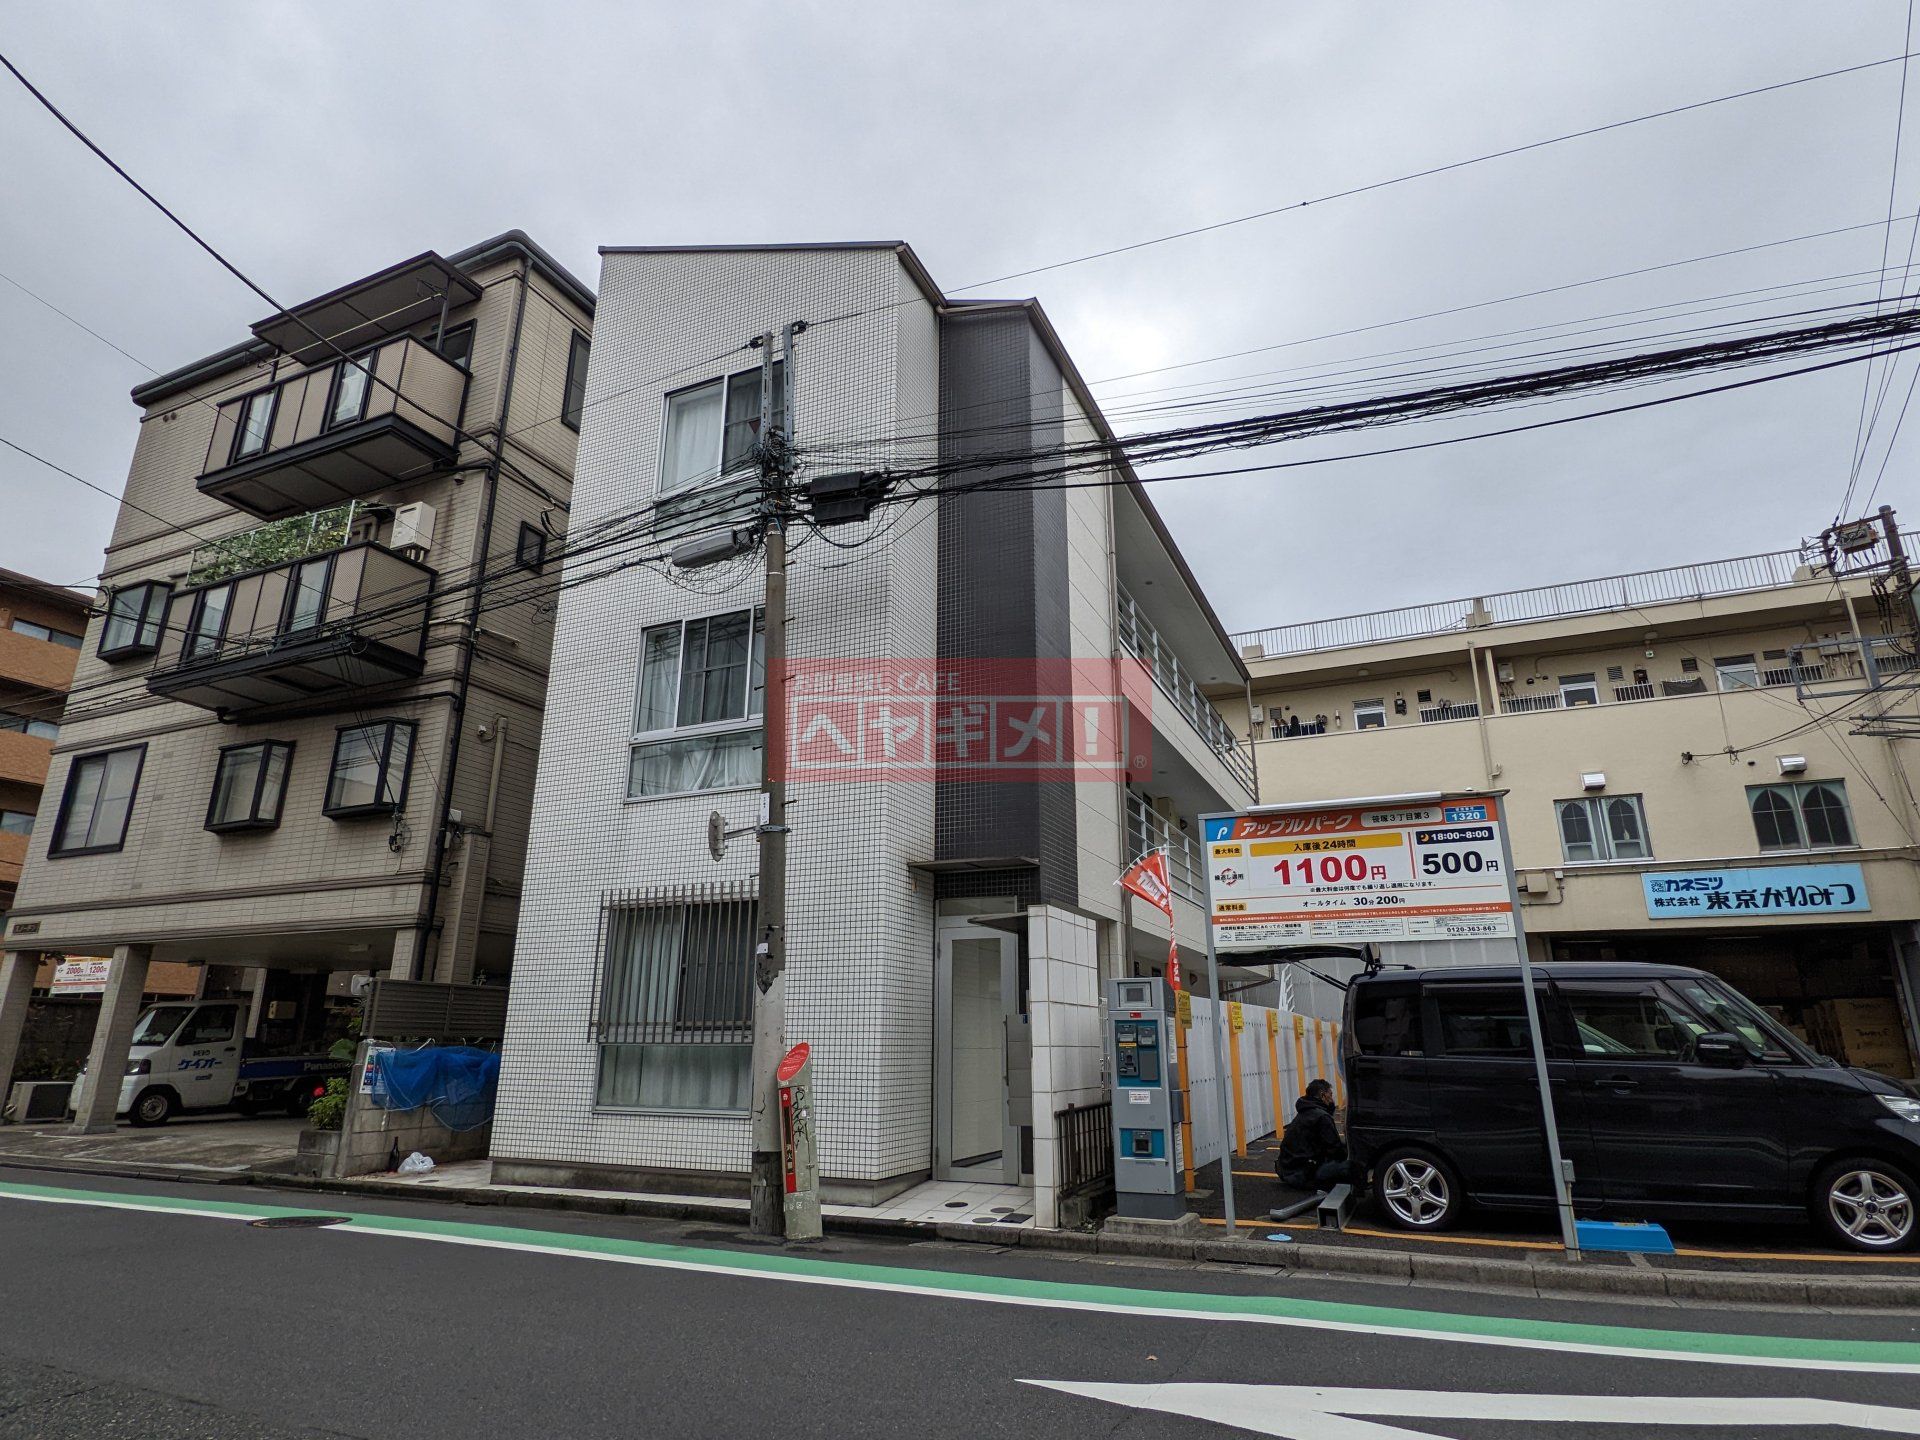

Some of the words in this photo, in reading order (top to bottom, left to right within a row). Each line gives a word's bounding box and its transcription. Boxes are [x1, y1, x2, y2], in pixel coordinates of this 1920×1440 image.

[1451, 811, 1481, 821] 1320
[1240, 814, 1353, 837] アップルパーク
[1214, 847, 1241, 855] 最大料金
[1293, 838, 1356, 852] 入庫後24時間
[1422, 850, 1499, 875] 500円
[1273, 854, 1387, 885] 1100円
[1665, 876, 1724, 893] カネミツ
[1302, 898, 1347, 908] オールタイム
[1653, 896, 1701, 908] 株式会社
[303, 1061, 346, 1072] Panason
